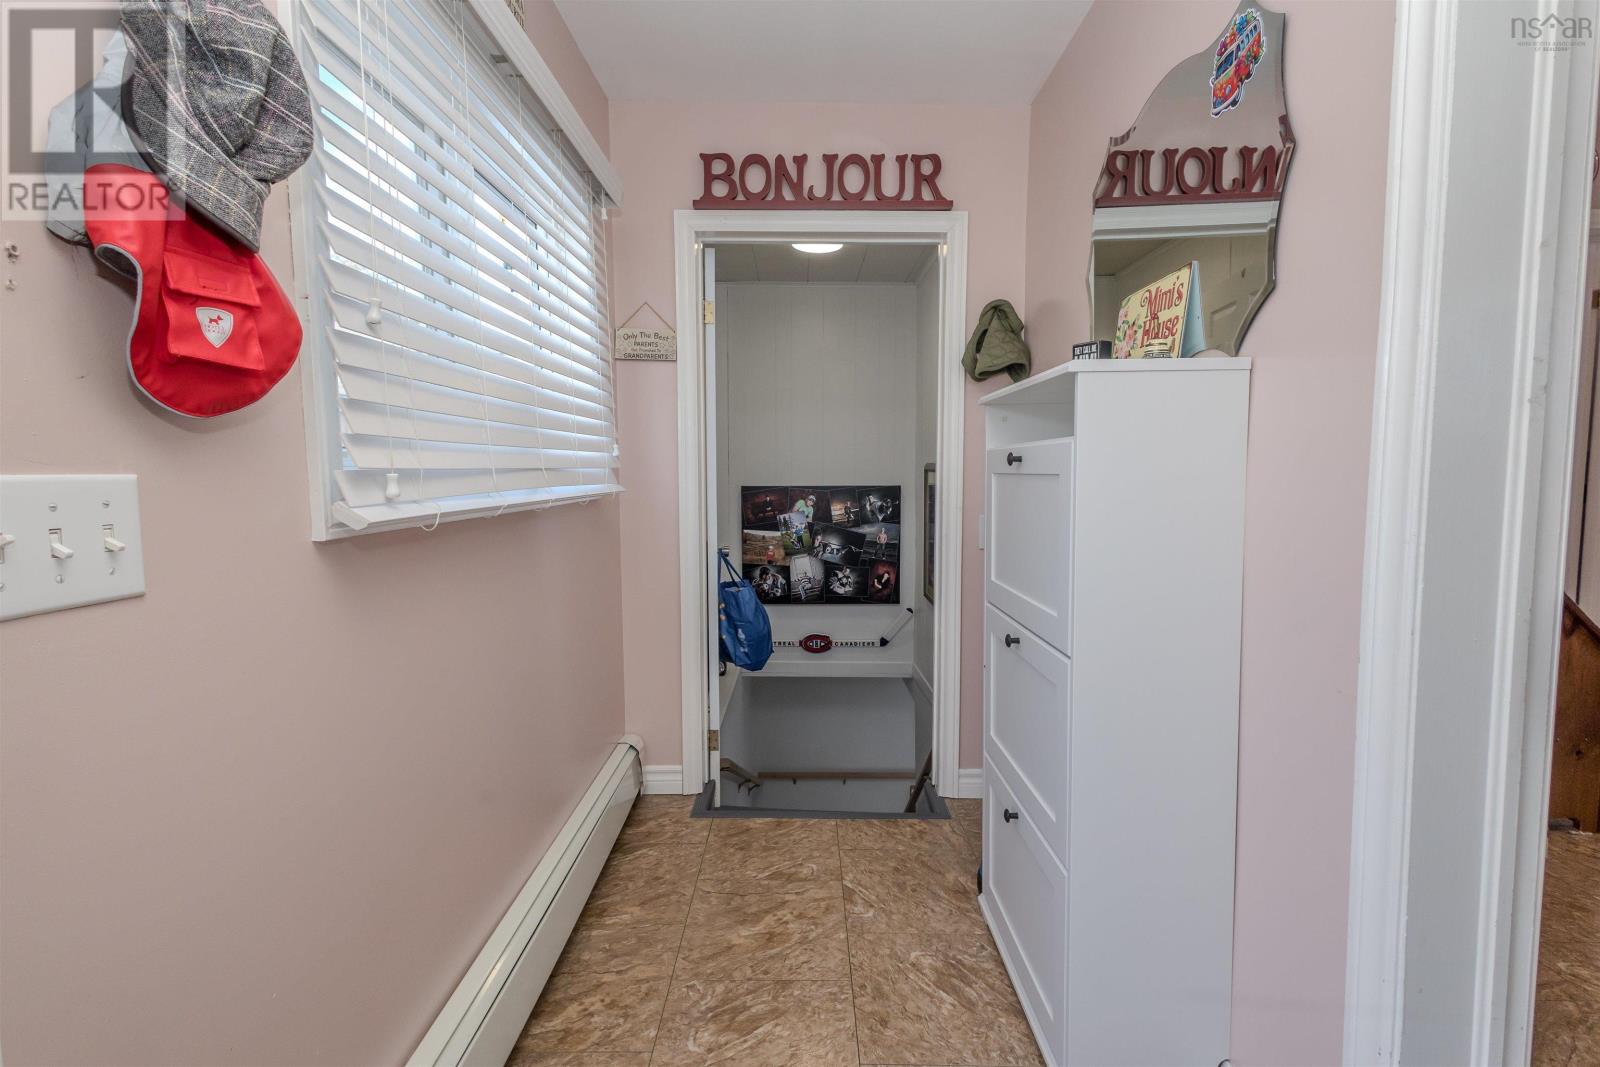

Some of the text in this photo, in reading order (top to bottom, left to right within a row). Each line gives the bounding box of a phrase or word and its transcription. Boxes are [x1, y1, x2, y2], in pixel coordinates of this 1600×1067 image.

[699, 153, 948, 202] BONJOUR
[1141, 276, 1185, 320] Mimi's
[623, 333, 638, 341] Only
[654, 332, 670, 341] Best
[1140, 315, 1180, 349] House
